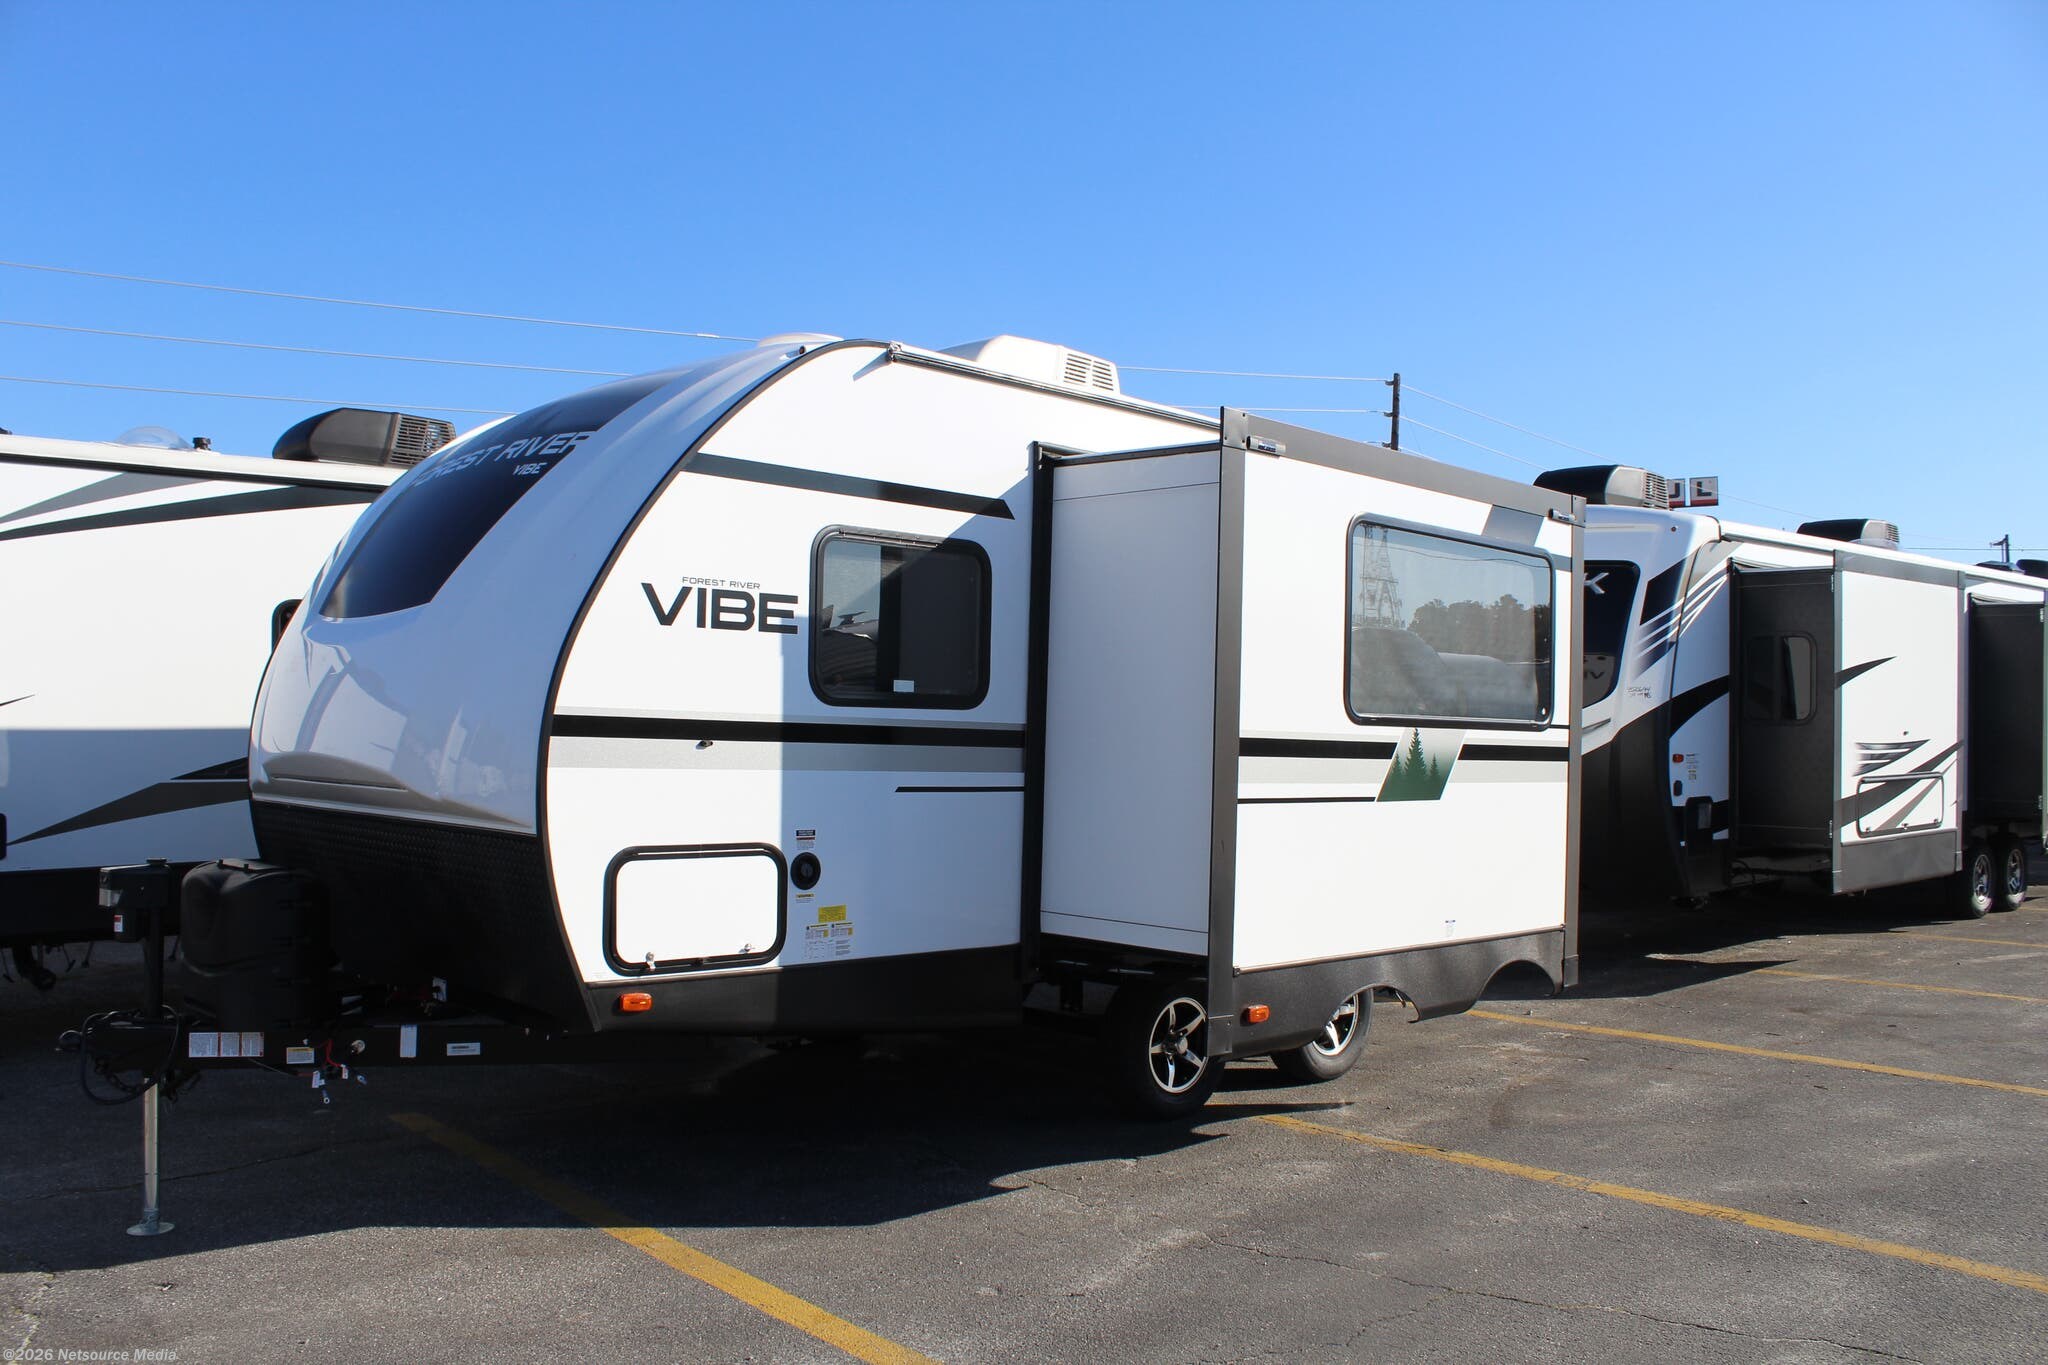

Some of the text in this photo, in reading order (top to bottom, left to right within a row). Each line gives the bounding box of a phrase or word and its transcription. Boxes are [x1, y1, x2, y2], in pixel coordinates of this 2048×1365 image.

[512, 461, 548, 476] VIBE
[681, 576, 761, 590] FOREST RIVER
[640, 582, 799, 635] VIBE
